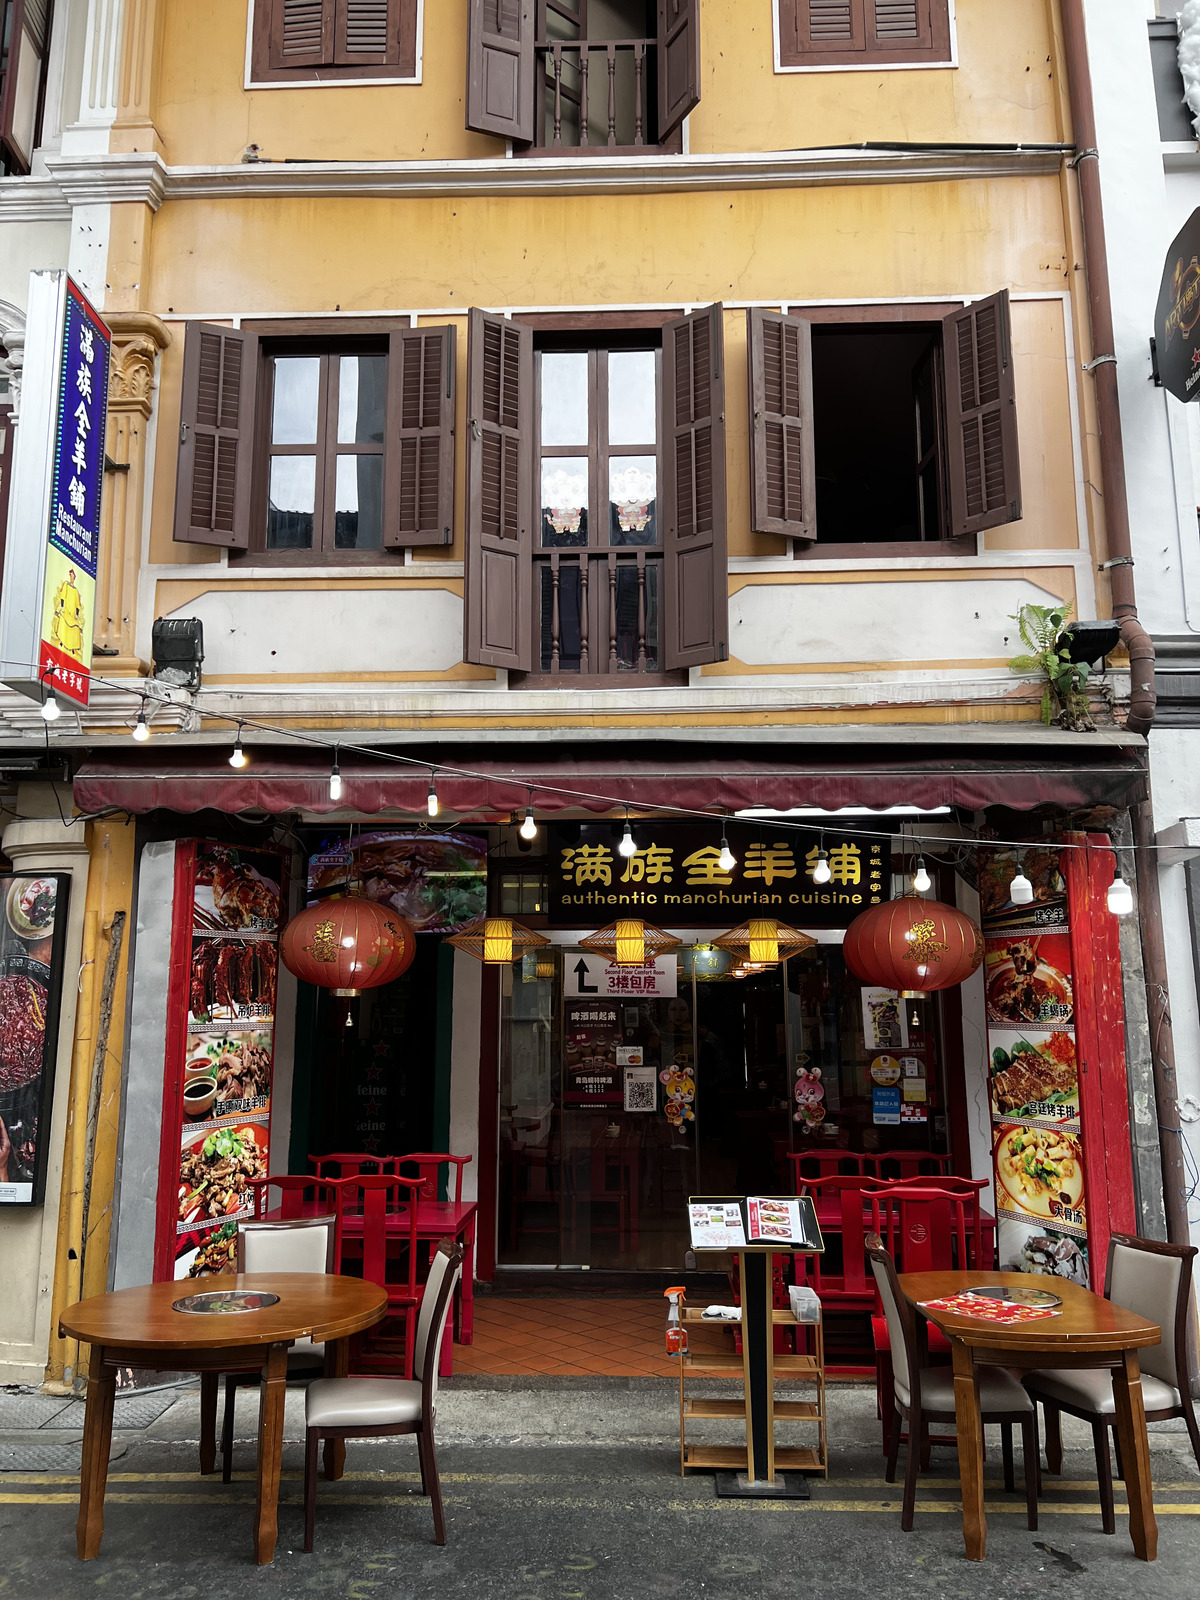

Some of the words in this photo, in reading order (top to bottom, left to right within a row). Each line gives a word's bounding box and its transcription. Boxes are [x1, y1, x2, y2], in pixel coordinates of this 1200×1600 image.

[58, 502, 92, 546] Restaurant
[55, 518, 92, 563] Manchurian
[561, 890, 658, 905] authentic
[664, 890, 783, 905] manchurian
[788, 891, 863, 905] cuisine
[608, 975, 656, 989] 3楼包房
[1028, 1101, 1076, 1120] 宫廷烤羊排
[1054, 1204, 1084, 1225] 大骨汤
